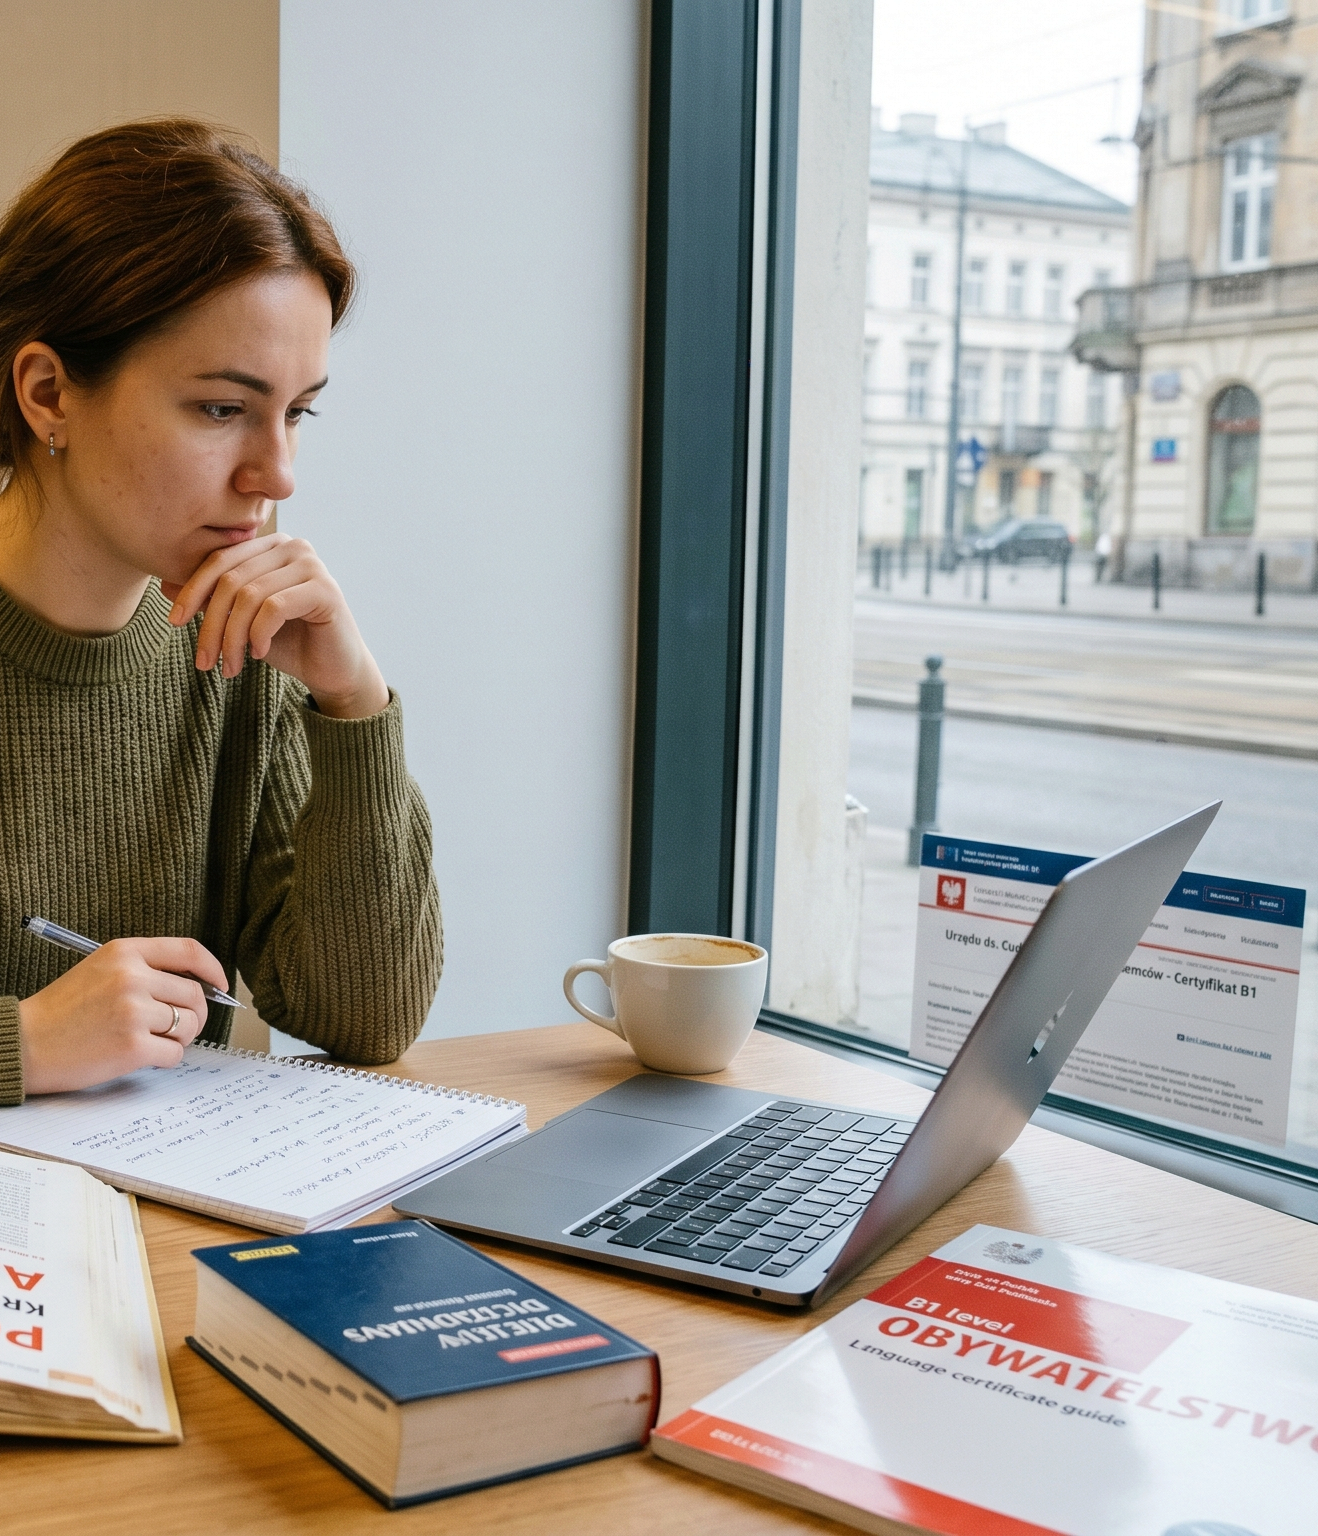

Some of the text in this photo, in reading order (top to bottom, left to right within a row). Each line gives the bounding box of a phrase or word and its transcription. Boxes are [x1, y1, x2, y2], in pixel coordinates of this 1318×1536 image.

[946, 929, 981, 946] Urzędu
[983, 936, 998, 949] ds.
[1241, 985, 1258, 998] B1
[904, 1297, 1015, 1334] B1 level
[878, 1316, 1318, 1453] OBYWATELSTW
[952, 1371, 1058, 1408] certificate
[1061, 1404, 1126, 1428] guide
